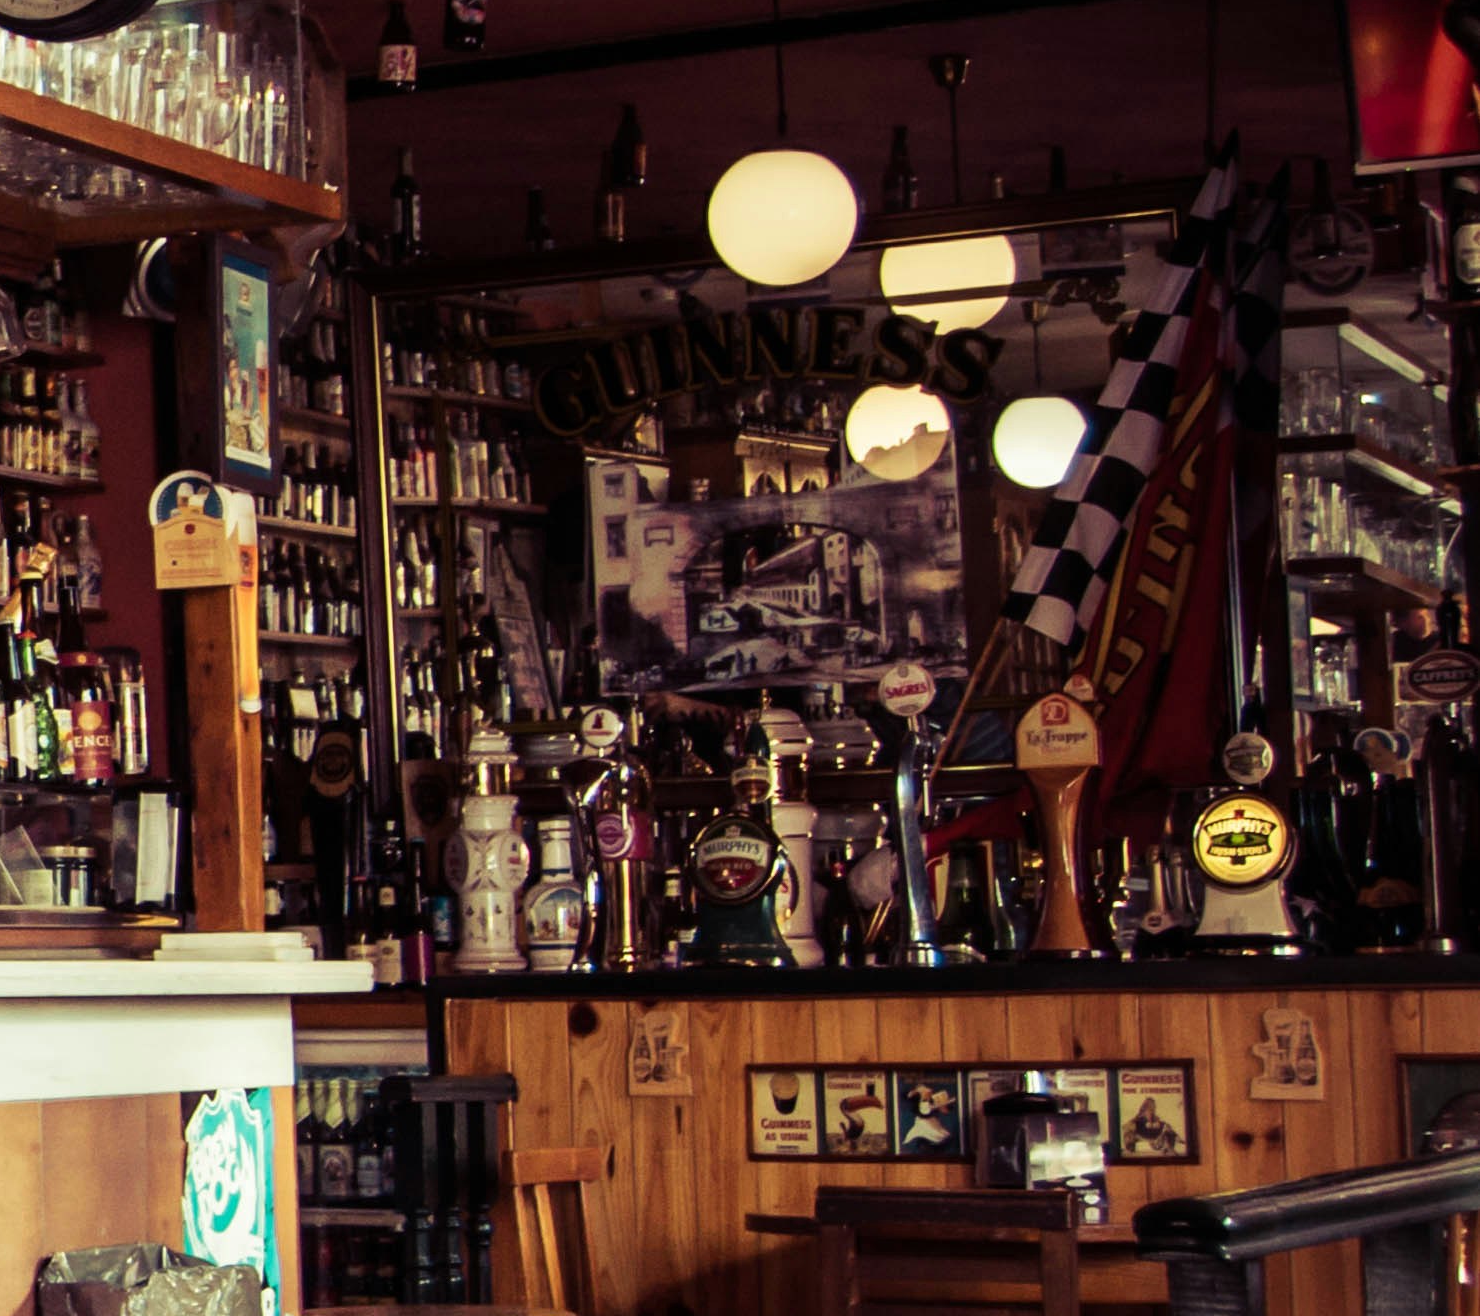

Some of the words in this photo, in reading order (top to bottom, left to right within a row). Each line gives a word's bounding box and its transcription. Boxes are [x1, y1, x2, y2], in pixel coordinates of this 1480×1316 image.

[532, 304, 1004, 438] GUINNESS
[885, 684, 929, 699] SAGRES
[1121, 1073, 1179, 1084] GUINNESS
[760, 1118, 812, 1130] GUINNESS
[765, 1131, 778, 1142] AS
[781, 1131, 809, 1142] USUAL
